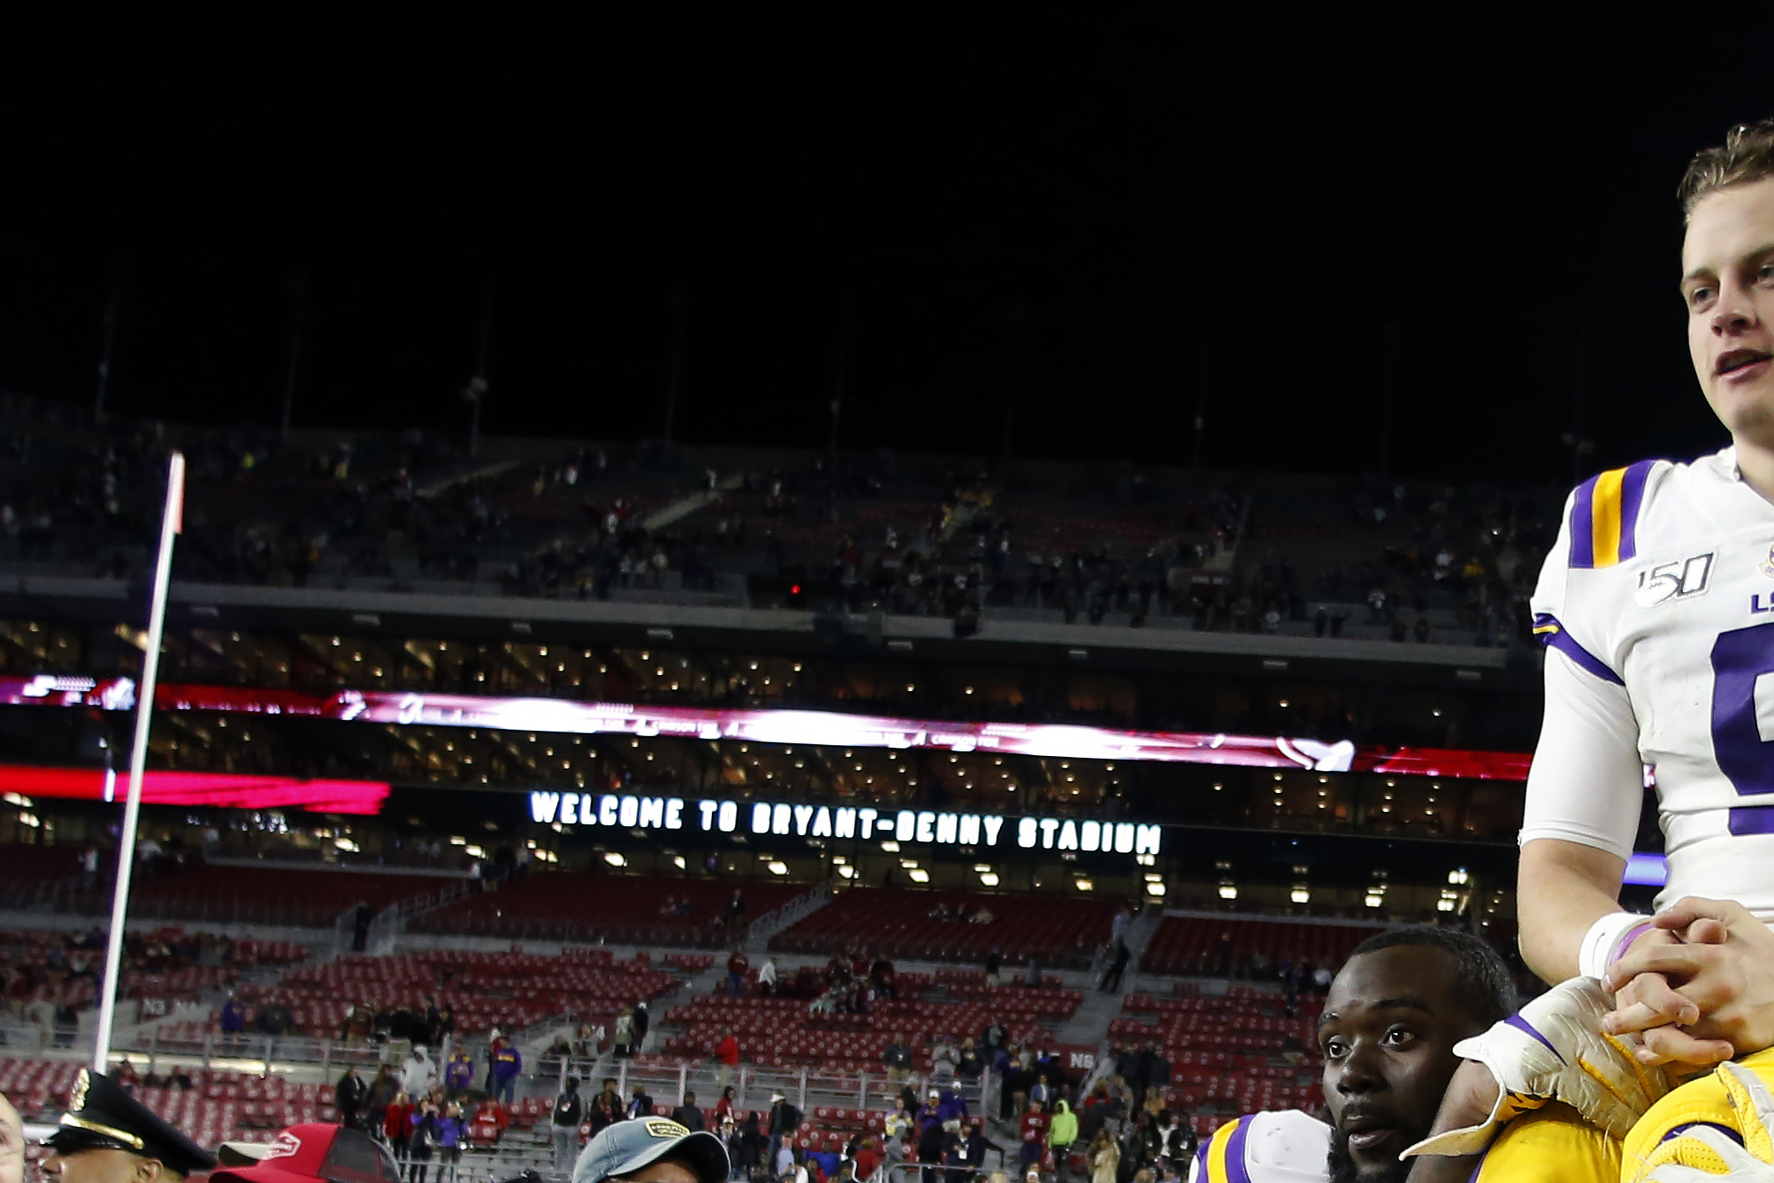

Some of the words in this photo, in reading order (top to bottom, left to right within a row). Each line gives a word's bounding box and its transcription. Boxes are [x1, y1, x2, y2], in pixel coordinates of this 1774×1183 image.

[1637, 552, 1715, 607] 150
[531, 791, 684, 830] WELCOME
[699, 800, 737, 832] TO
[751, 802, 1003, 846] BRYANT-DENNY
[1017, 817, 1163, 855] STADIUM
